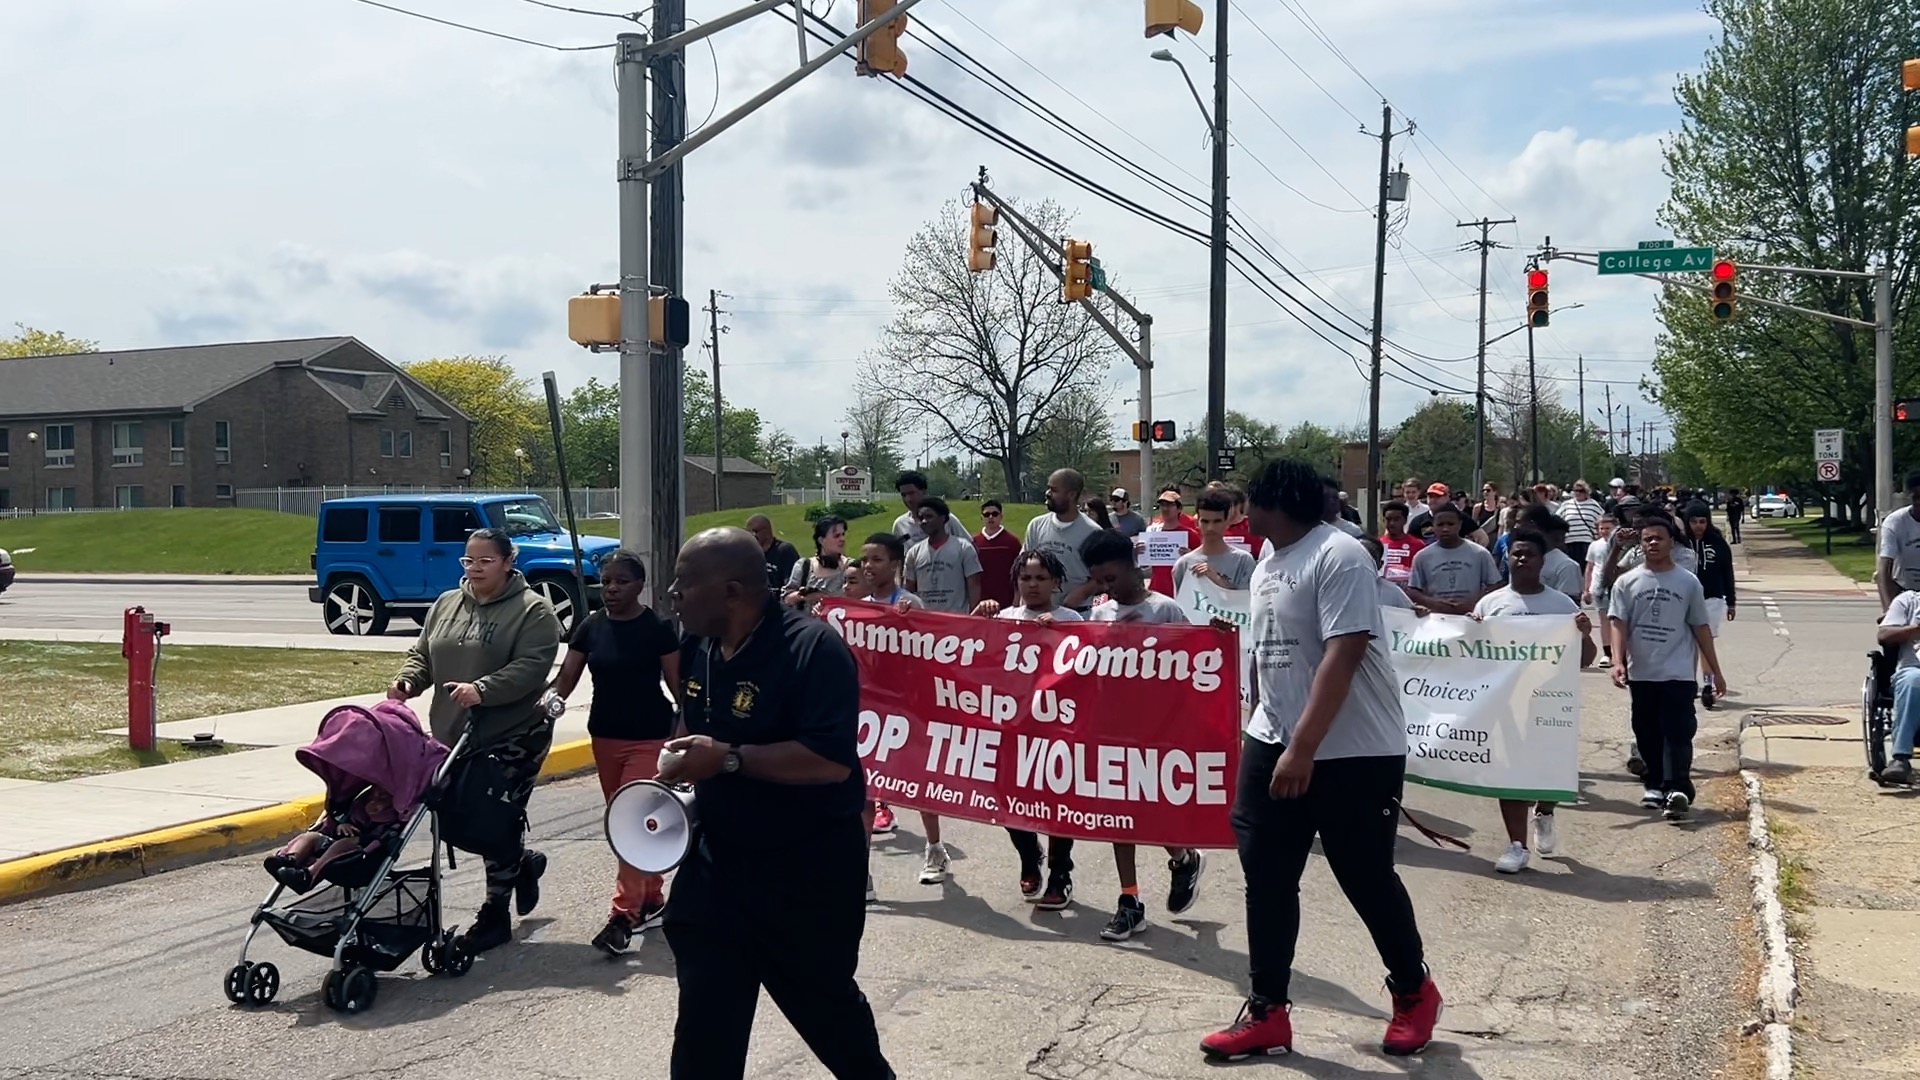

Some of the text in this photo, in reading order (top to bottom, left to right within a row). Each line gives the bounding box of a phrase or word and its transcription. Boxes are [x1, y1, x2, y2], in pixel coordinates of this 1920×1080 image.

[1644, 241, 1660, 249] 700
[1604, 253, 1706, 270] College Av
[827, 607, 1223, 692] Summer is Coming
[1391, 629, 1566, 665] Youth Ministry
[934, 676, 1076, 725] Help Us
[1532, 688, 1573, 698] Success
[1562, 705, 1573, 713] or
[1406, 722, 1489, 747] ent Camp
[1535, 717, 1573, 728] Failure
[856, 710, 1227, 805] OP THE VIOLENCE
[1415, 741, 1491, 764] Succeed
[866, 768, 1134, 831] Young Men Inc. Youth Program
